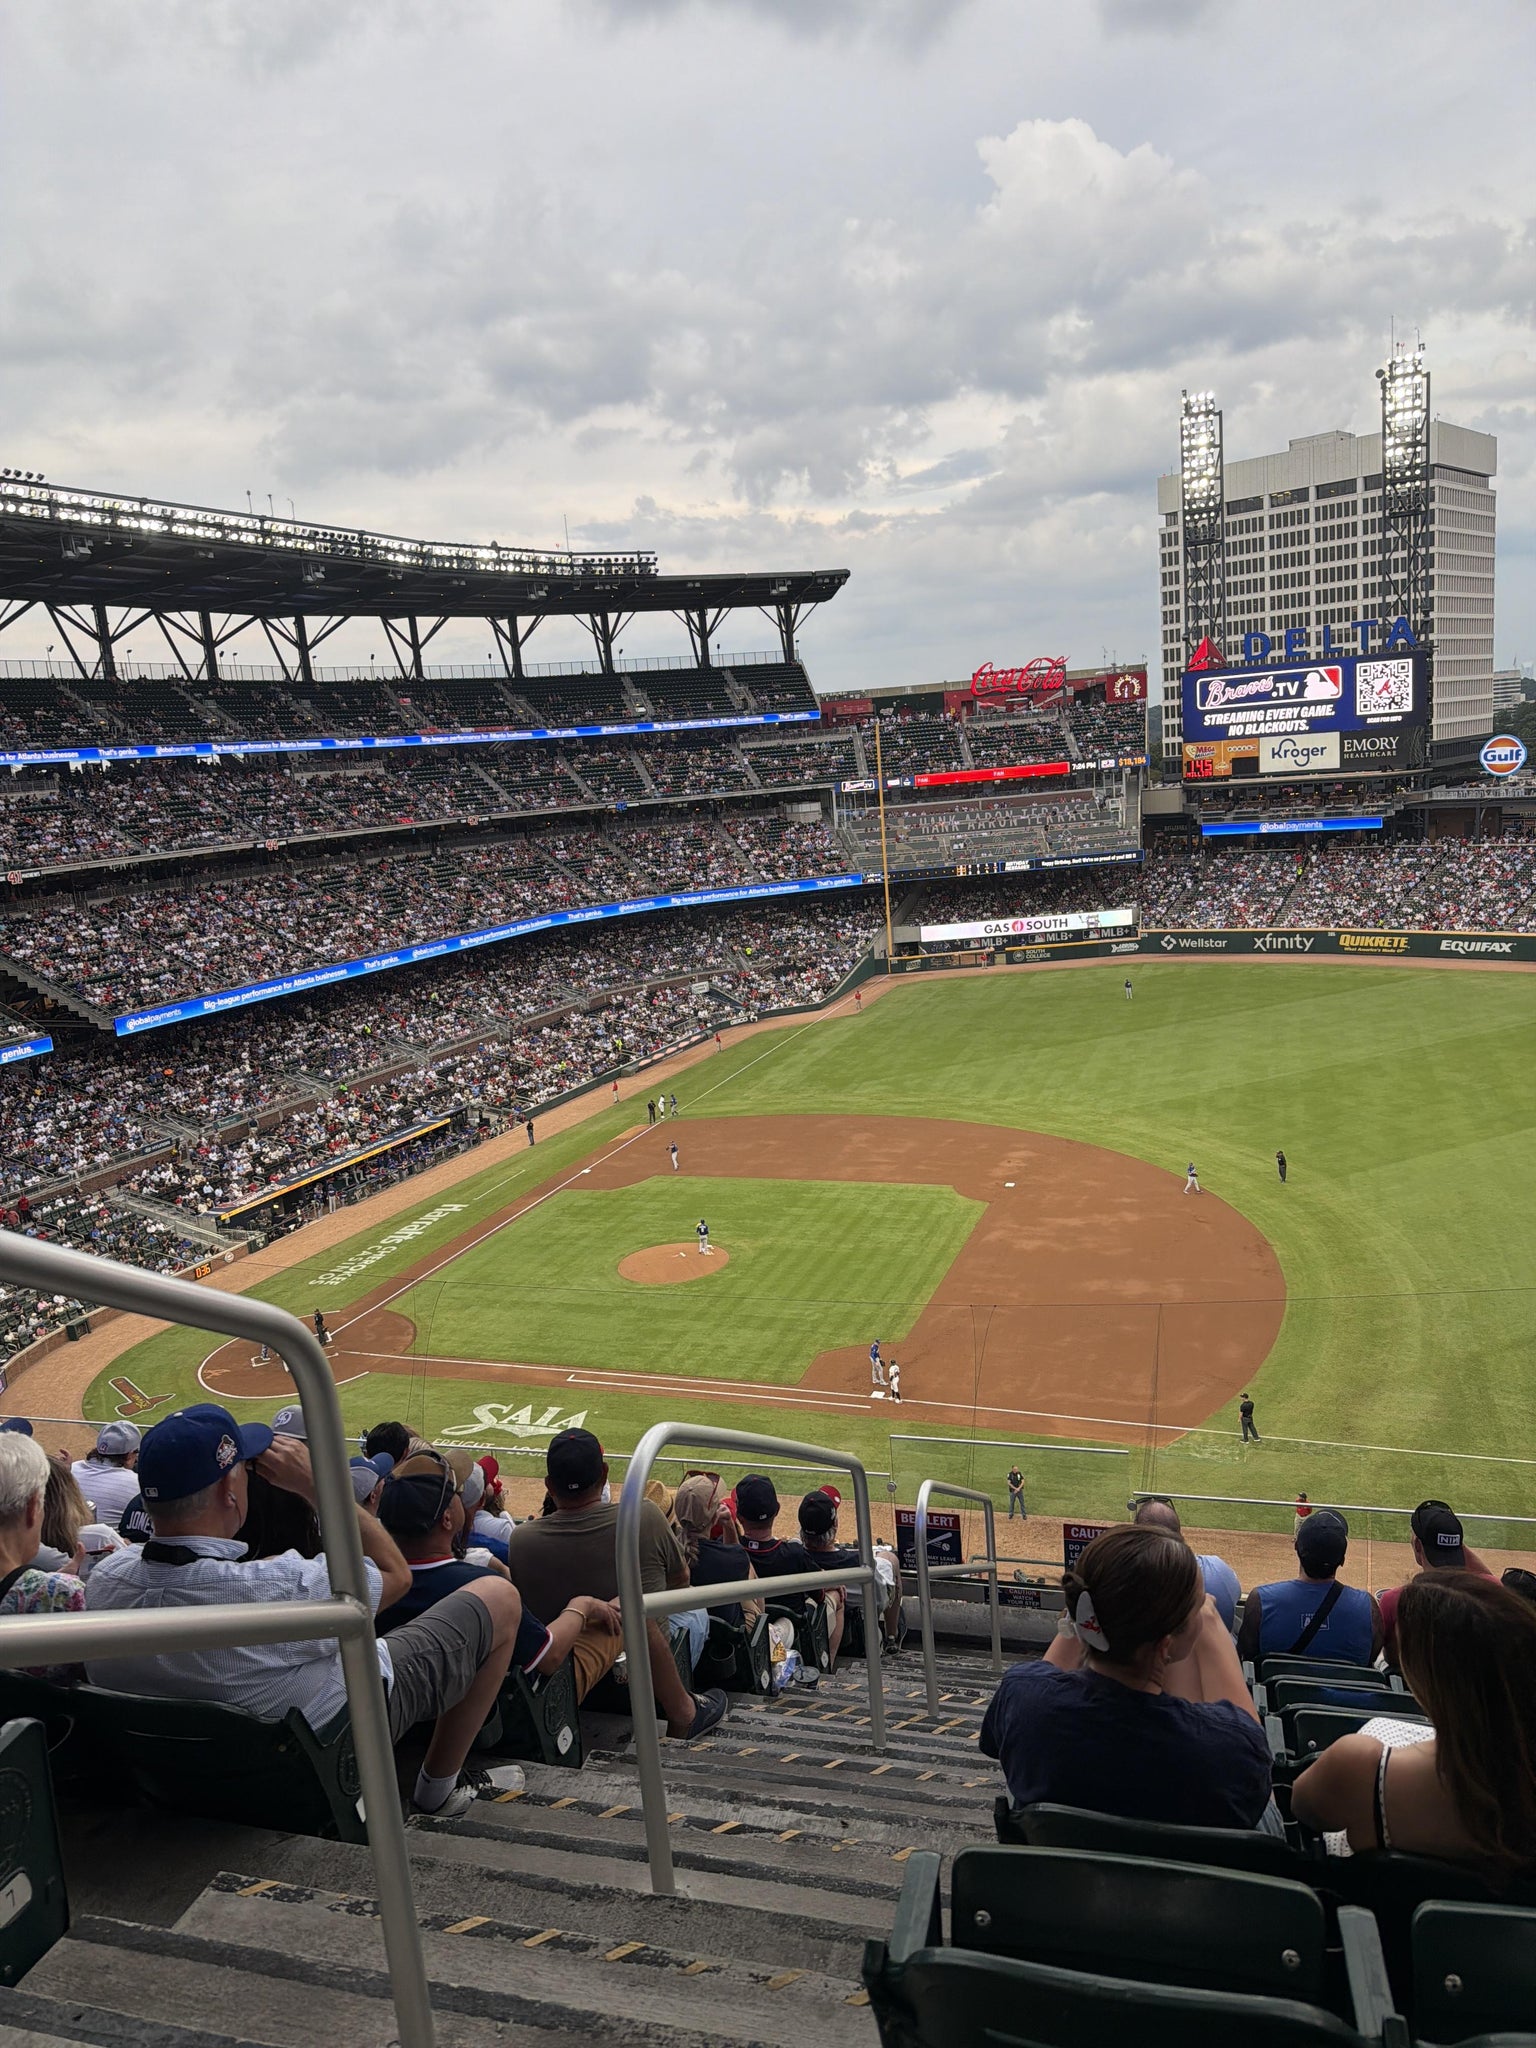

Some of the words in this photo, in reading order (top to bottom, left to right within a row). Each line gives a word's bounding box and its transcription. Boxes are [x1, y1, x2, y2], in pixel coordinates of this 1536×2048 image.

[1244, 616, 1418, 661] DELTA
[1205, 675, 1273, 707] Braves
[1203, 710, 1264, 727] STREAMING
[1265, 707, 1299, 722] EVERY
[1301, 704, 1335, 719] GAME.
[1228, 724, 1243, 736] NO
[1243, 719, 1310, 735] BLACKOUTS.
[98, 748, 118, 756] That's
[118, 747, 139, 757] genius.
[1343, 736, 1399, 752] EMORY
[17, 753, 41, 761] Atlanta
[42, 750, 79, 759] businesses
[1271, 738, 1327, 767] Kroger
[1343, 749, 1397, 759] HEALTHCARE
[1483, 748, 1522, 762] Gulf
[1190, 760, 1212, 772] 145
[919, 814, 960, 834] HANK
[965, 810, 1017, 830] AARON
[1021, 803, 1096, 824] TERRACE
[671, 894, 701, 904] Big-league
[702, 891, 739, 901] performance
[748, 887, 768, 895] Atlanta
[769, 883, 800, 892] businesses
[984, 924, 1009, 933] GAS
[1027, 918, 1068, 930] SOUTH
[1101, 928, 1130, 938] MLB+
[1046, 932, 1074, 942] MLB+
[1178, 938, 1228, 948] Wellstar
[1253, 933, 1314, 952] xfinity
[1339, 934, 1408, 949] QUIKRETE
[1439, 939, 1511, 955] EQUIFAX
[364, 959, 381, 970] That's
[381, 956, 400, 967] genius.
[203, 995, 241, 1010] Big-league
[241, 986, 283, 1003] performance
[283, 981, 293, 989] for
[293, 976, 315, 987] Atlanta
[315, 968, 348, 982] businesses
[1, 1046, 34, 1060] genius.
[308, 1245, 383, 1285] CASINOS
[323, 1246, 397, 1286] CHEROKEE
[441, 1403, 588, 1437] SAIA
[927, 1515, 954, 1527] LERT
[1070, 1527, 1106, 1539] CAUT
[5, 1889, 15, 1906] 7
